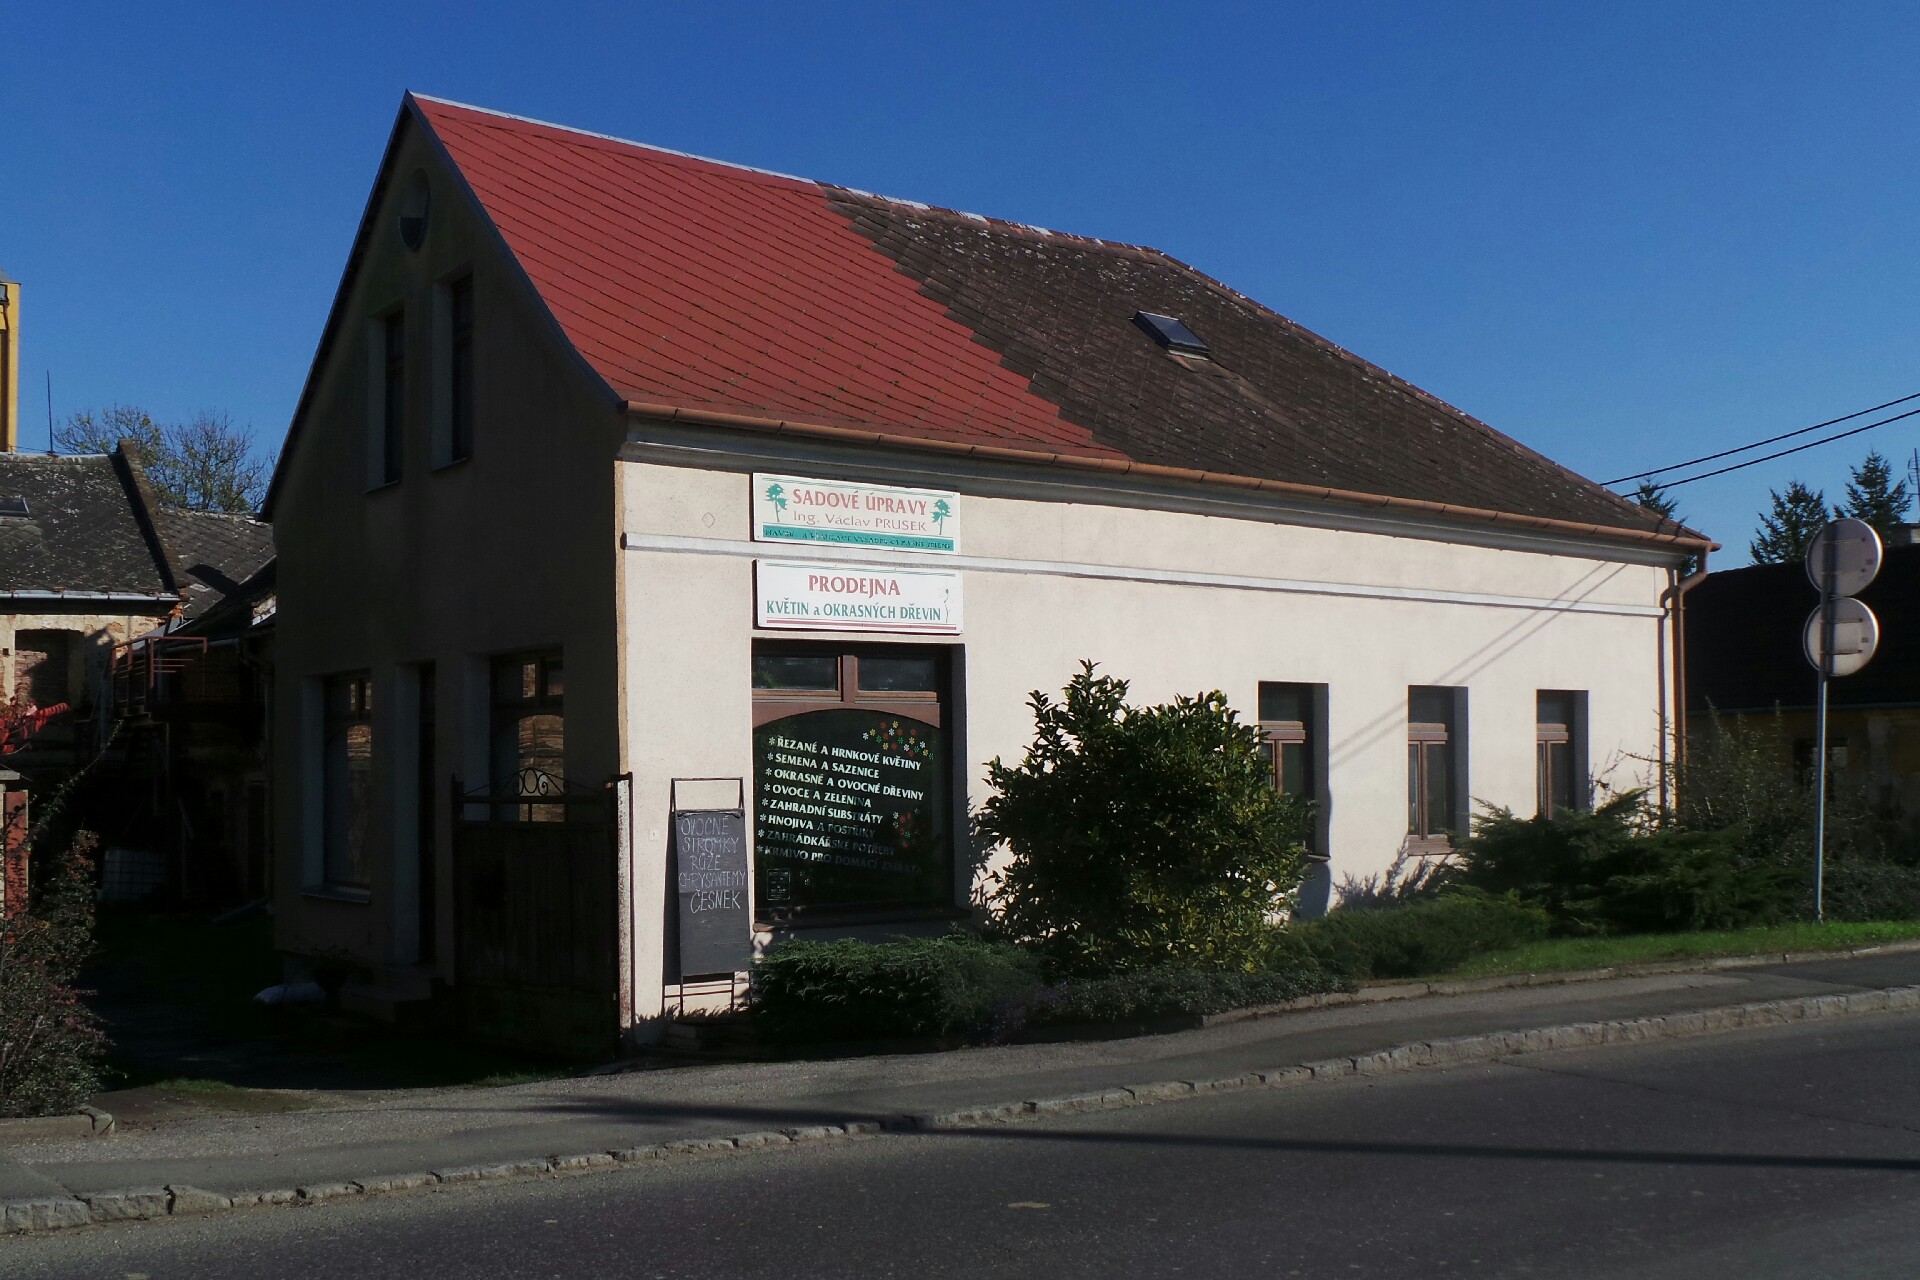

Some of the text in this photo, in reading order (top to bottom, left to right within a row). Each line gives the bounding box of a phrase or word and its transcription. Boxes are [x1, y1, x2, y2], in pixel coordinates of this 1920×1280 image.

[793, 488, 927, 515] SADOVÉ ÚPRAVY
[794, 511, 820, 525] Ing.
[825, 514, 870, 527] Václav
[808, 575, 900, 598] PRODEJNA
[766, 597, 941, 621] KVĚTIN a OKRASNÝCH DŘEVIN
[777, 735, 922, 771] ŘEZANÉ A HRNKOVÉ KVĚTINY
[775, 753, 879, 779] SEMENA A SAZENICE
[772, 784, 872, 808] OVOCE A ZELENINA
[774, 769, 924, 801] OKRASNÉ A OVOCNÉ DŘEVINY
[770, 799, 883, 824] ZAHRADNÍ SUBSTRÁTY
[681, 815, 729, 836] OVOCNÉ
[768, 815, 876, 838] HNOJIVA A POSTŘIKY
[682, 836, 739, 854] STROMKY
[767, 830, 849, 849] ZAHRÁDKÁŘSKÉ
[690, 852, 721, 871] RŮŽE
[765, 846, 808, 860] KRMIVO
[811, 852, 832, 863] PRO
[679, 870, 746, 889] CHRYSANTEMY
[690, 889, 741, 913] ČESNEK
